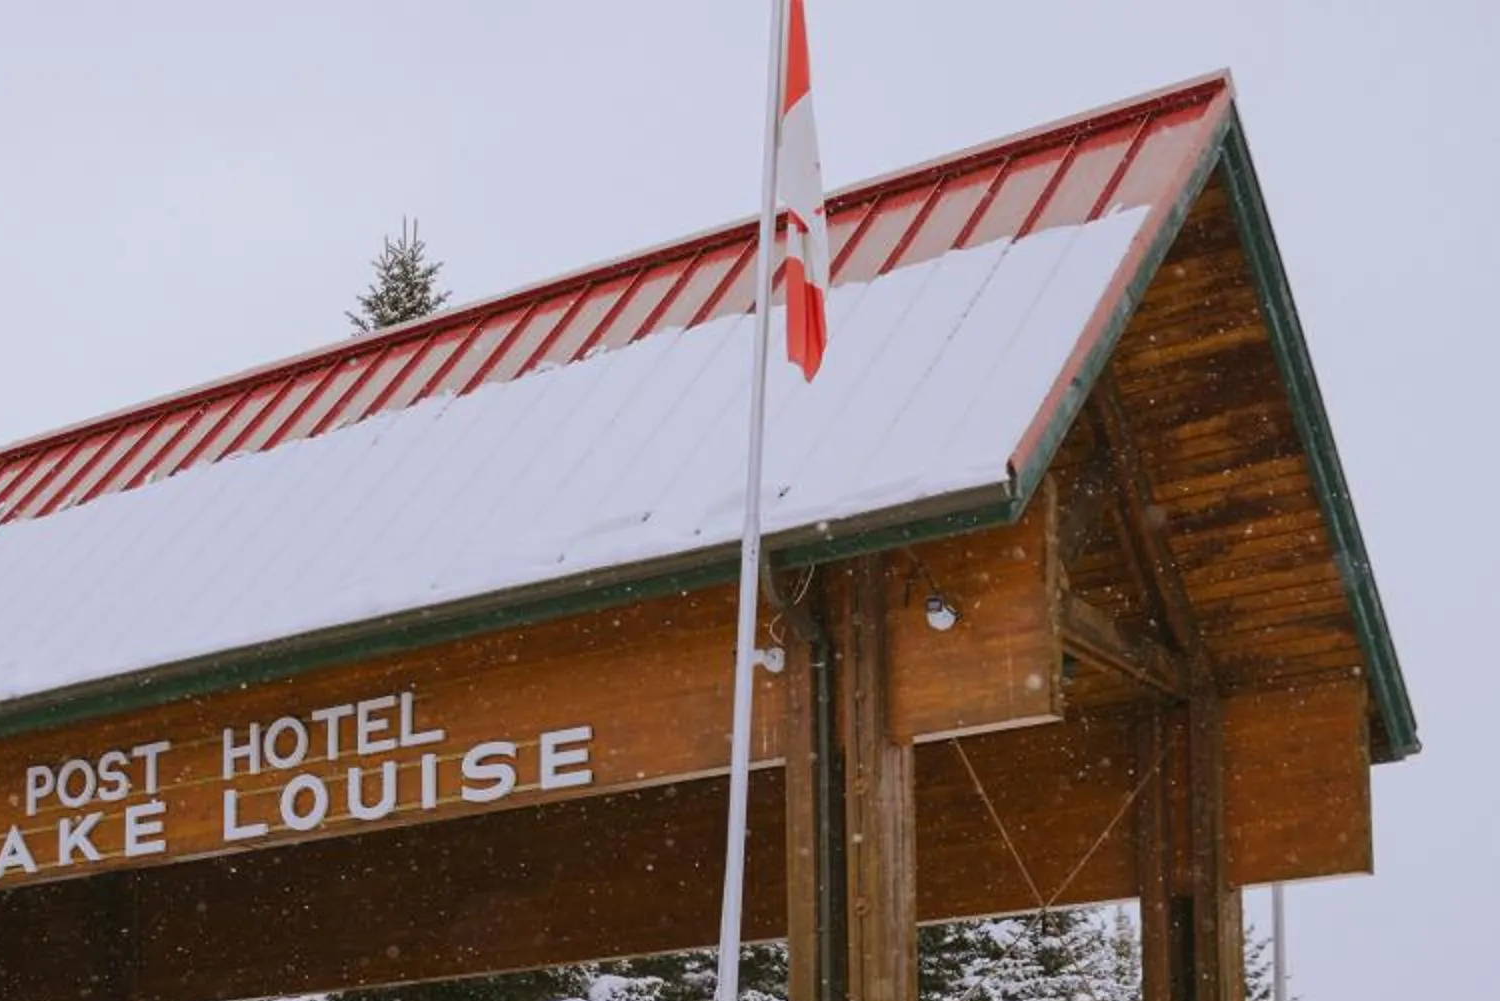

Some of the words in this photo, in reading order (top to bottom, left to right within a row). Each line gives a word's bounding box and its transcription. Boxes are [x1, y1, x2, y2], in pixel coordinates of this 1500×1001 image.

[26, 741, 170, 816] POST
[222, 692, 444, 780] HOTEL
[222, 726, 593, 841] LOUISE
